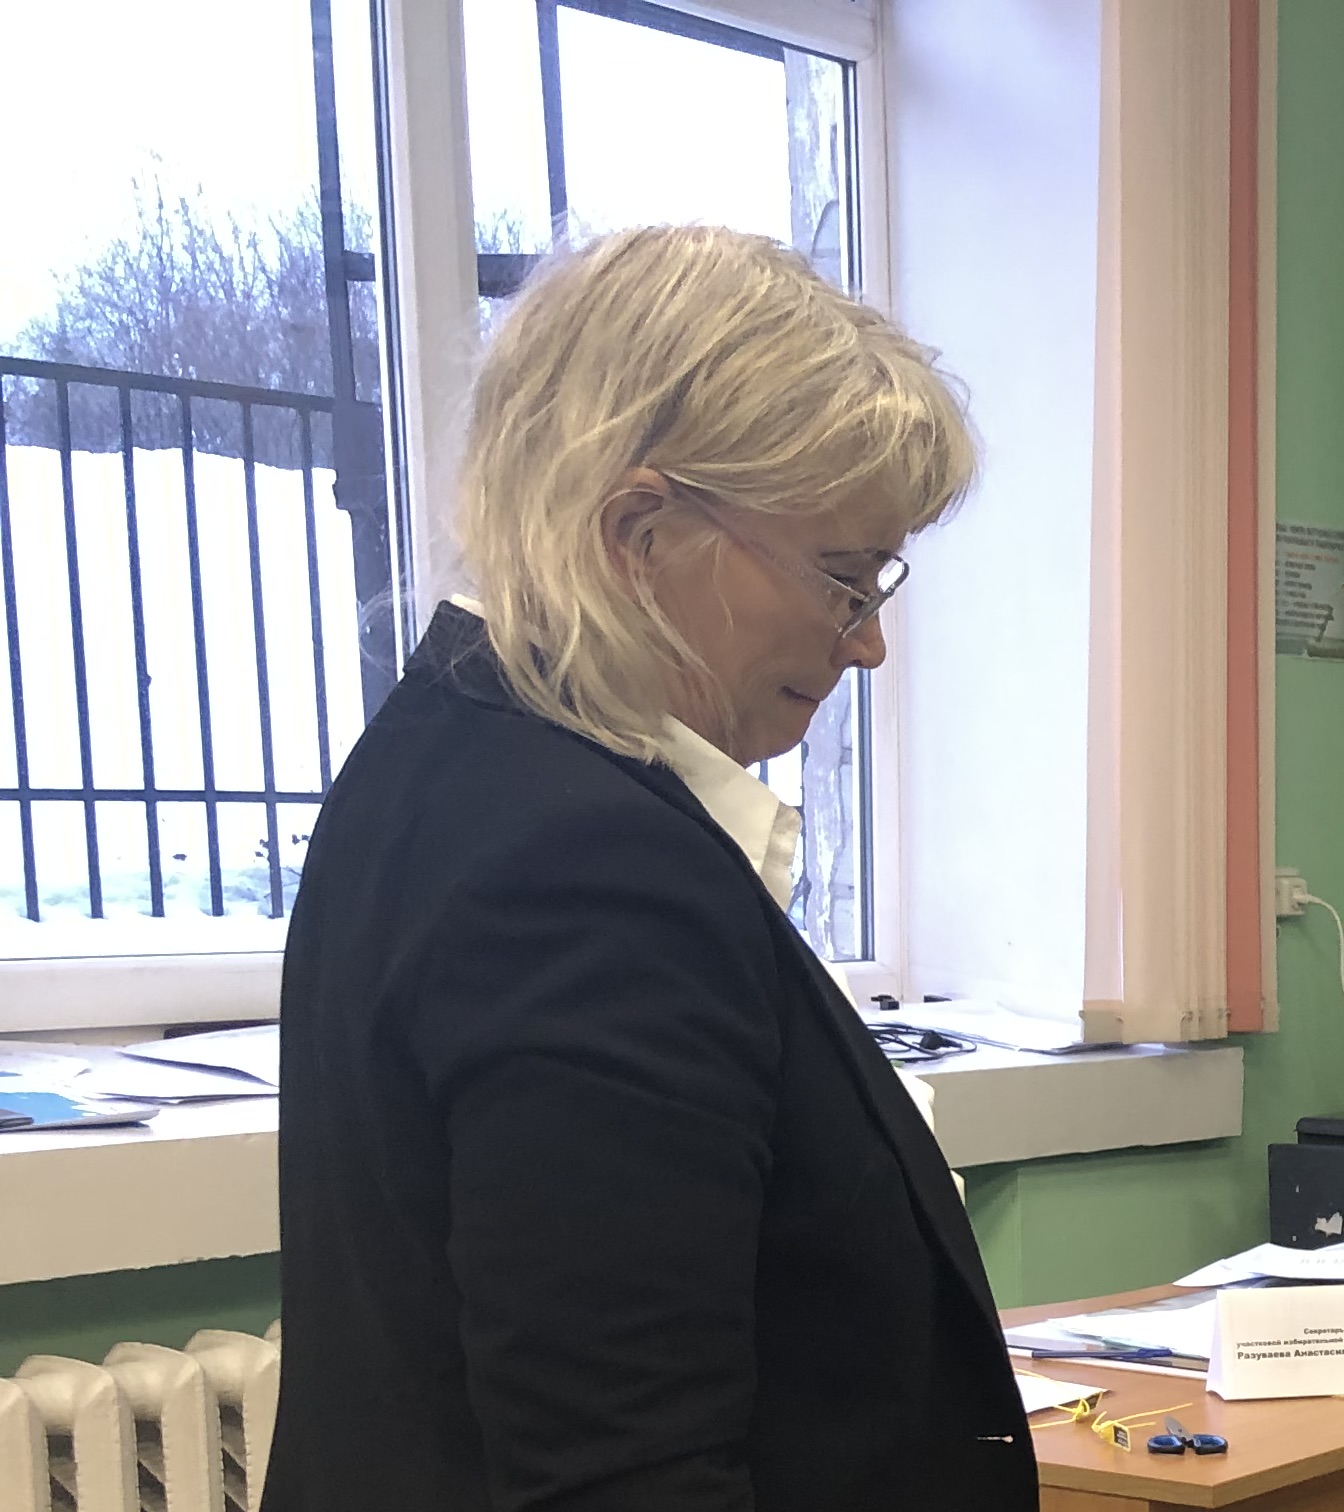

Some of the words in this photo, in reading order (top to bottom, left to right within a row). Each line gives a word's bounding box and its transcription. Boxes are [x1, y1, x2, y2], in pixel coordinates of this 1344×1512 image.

[1303, 1327, 1344, 1336] Секретарь
[1236, 1339, 1282, 1348] участковой
[1283, 1337, 1344, 1346] избирательной
[1237, 1350, 1292, 1361] Разуваева
